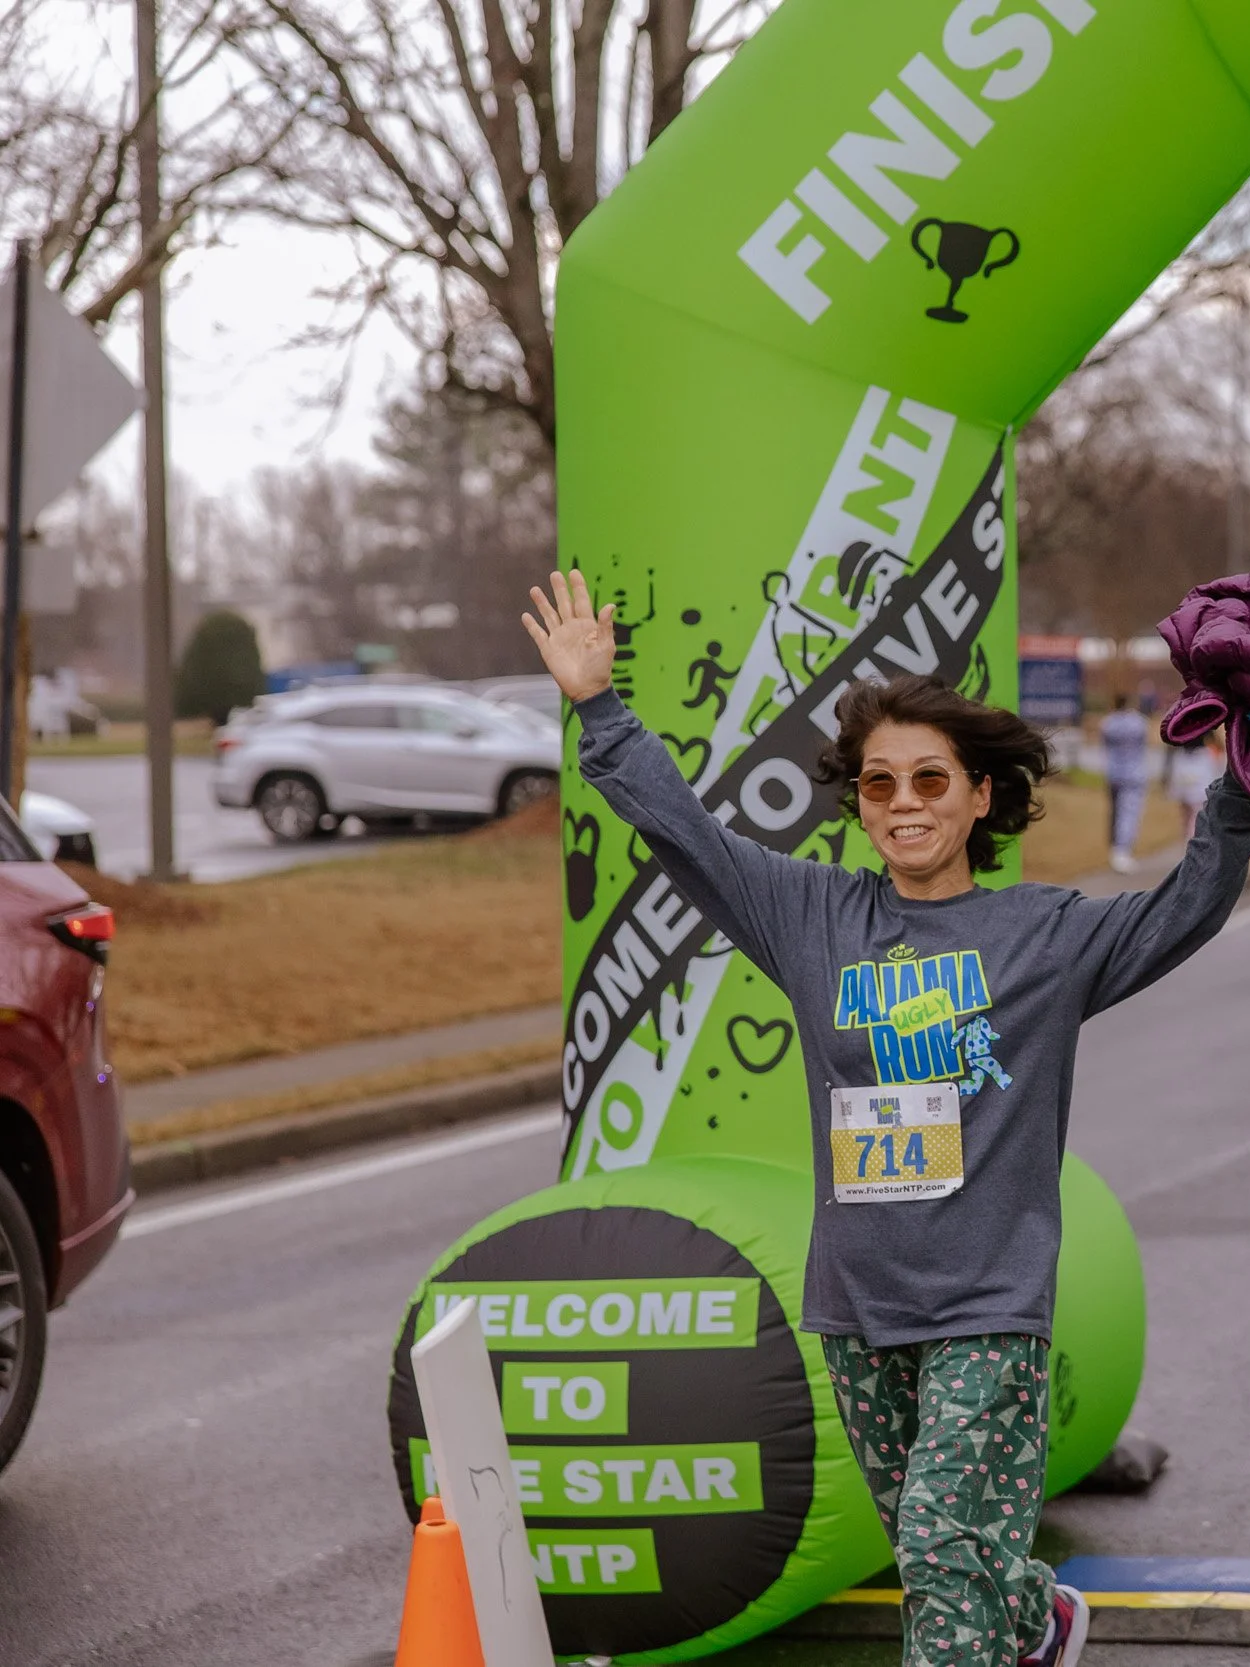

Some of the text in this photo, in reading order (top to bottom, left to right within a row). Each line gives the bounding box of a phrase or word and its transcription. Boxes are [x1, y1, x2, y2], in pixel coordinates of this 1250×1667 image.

[737, 0, 1098, 325] FINIS
[563, 872, 703, 1160] COME
[972, 464, 1005, 571] S
[893, 992, 949, 1031] UGLY
[869, 1016, 963, 1085] RUN
[855, 1132, 928, 1178] 714
[845, 1183, 946, 1195] www.FiveStarNTP.com
[521, 1375, 607, 1422] TO
[563, 1457, 740, 1505] STAR
